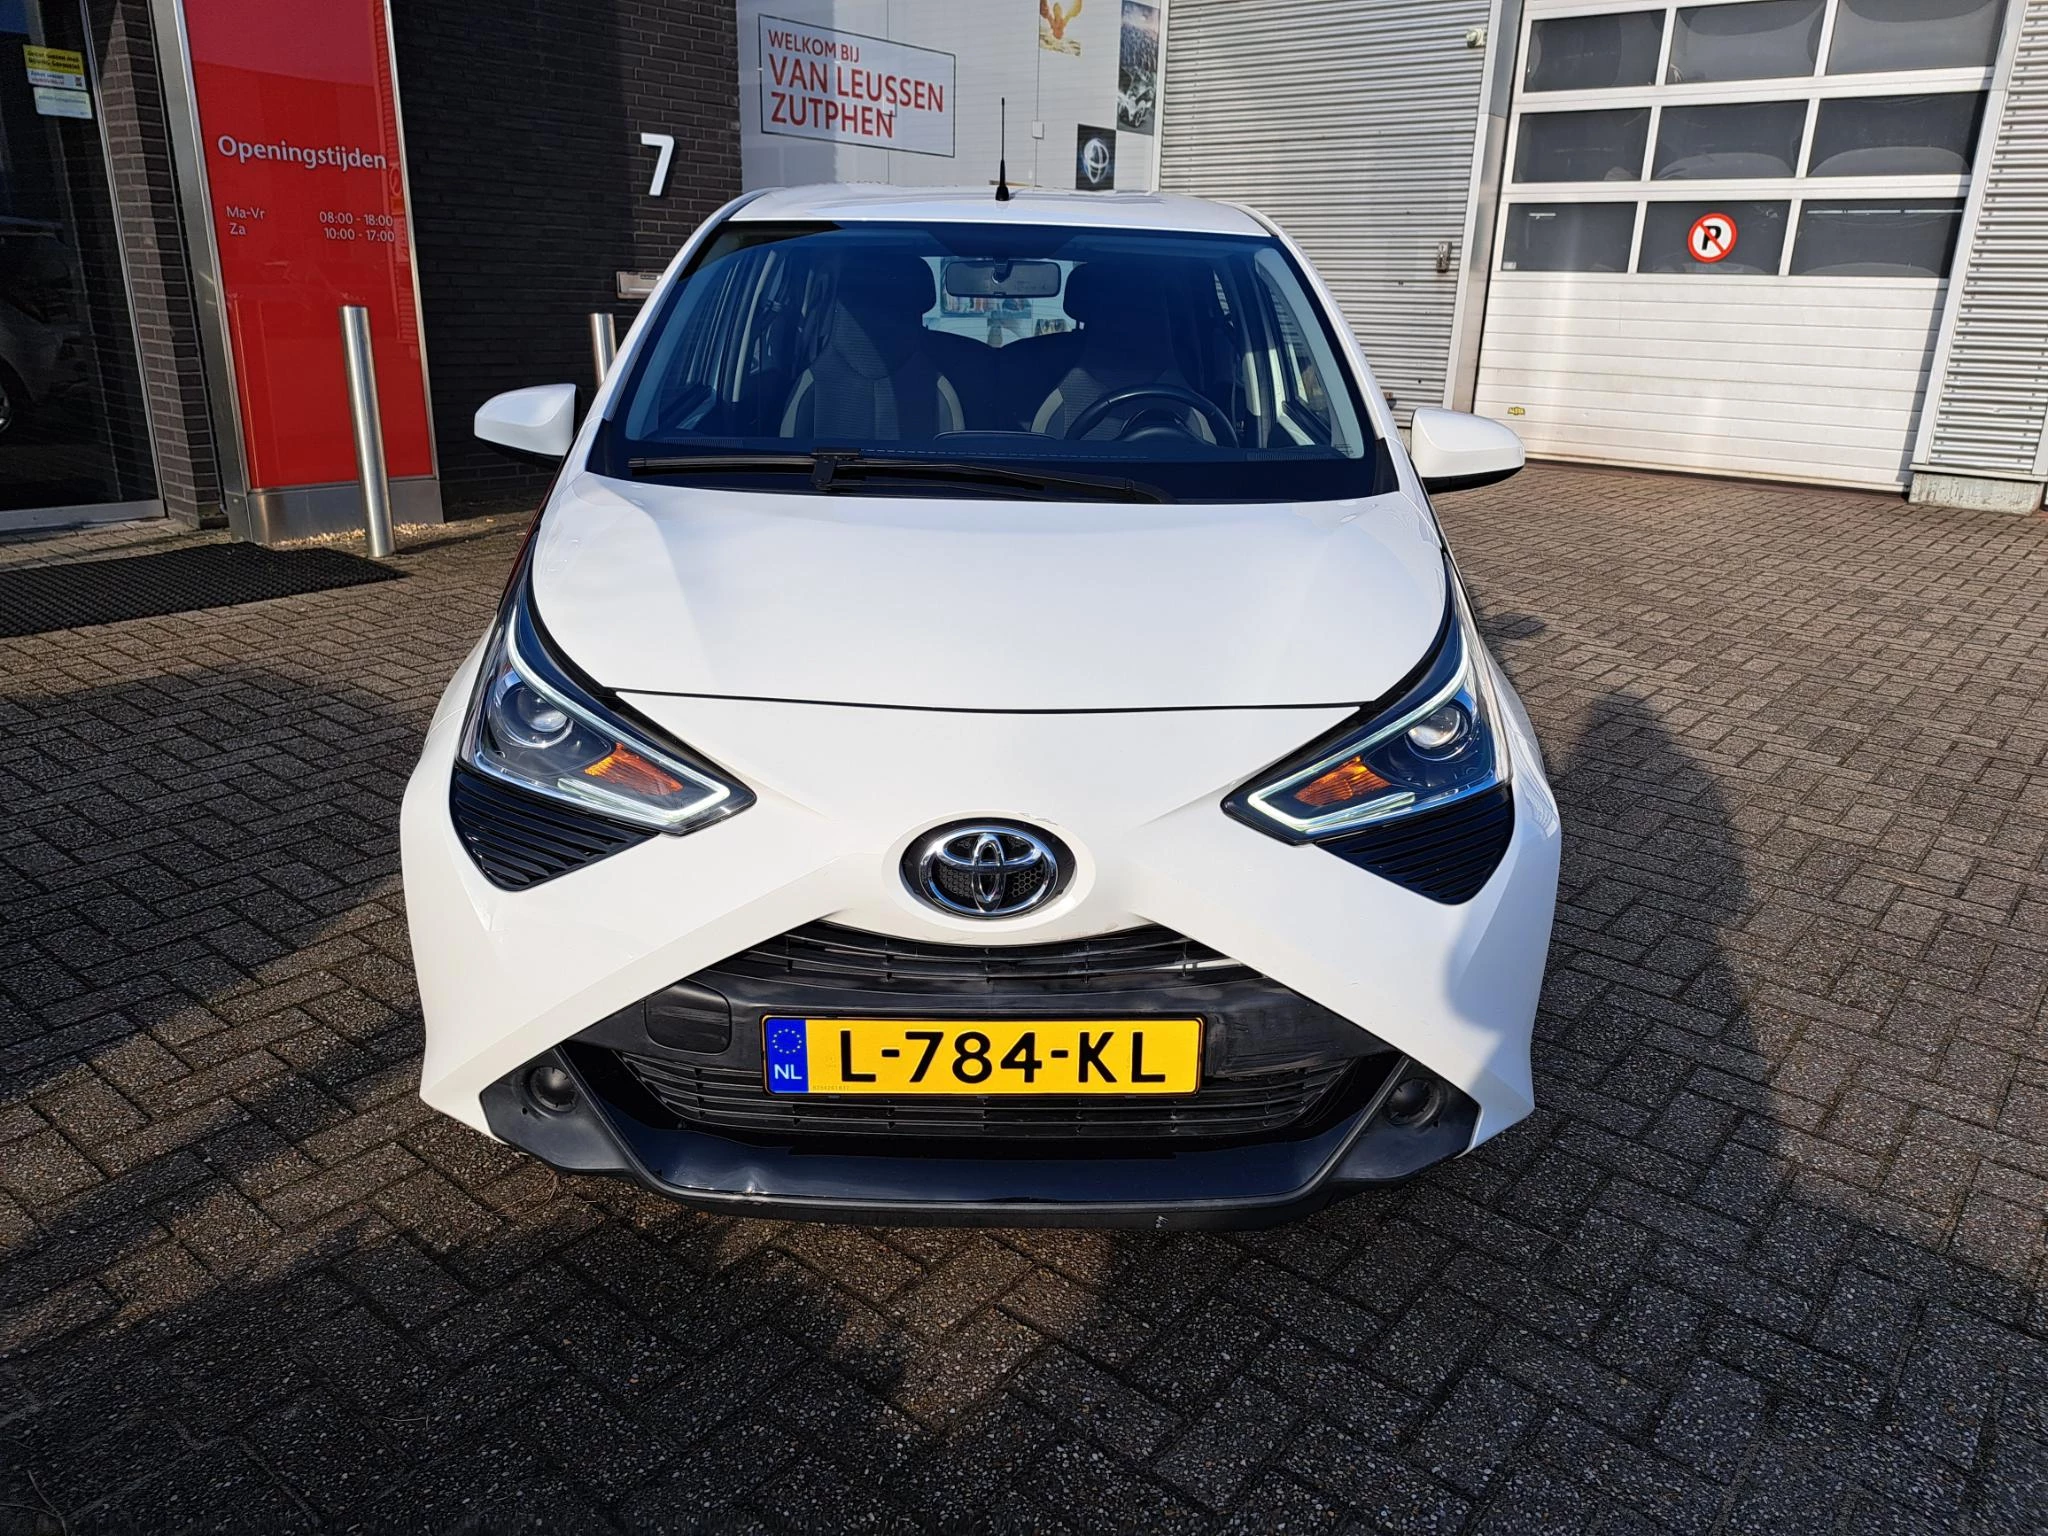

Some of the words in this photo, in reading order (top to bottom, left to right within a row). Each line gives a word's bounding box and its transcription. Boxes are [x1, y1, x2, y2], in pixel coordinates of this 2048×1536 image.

[768, 29, 837, 59] WELKOM
[840, 44, 860, 63] BIJ
[768, 53, 829, 94] VAN
[837, 66, 944, 113] LEUSSEN
[771, 91, 893, 138] ZUTPHEN
[217, 135, 388, 172] Openingstijden
[640, 132, 676, 197] 7
[226, 205, 265, 221] Ma-Vr
[319, 211, 353, 225] 08:00
[363, 213, 394, 227] 18:00
[229, 222, 247, 236] Za
[323, 227, 355, 241] 10:00
[366, 229, 395, 243] 17:00
[1701, 225, 1722, 251] P
[774, 1063, 803, 1080] NL
[839, 1029, 1166, 1084] L-784-KL
